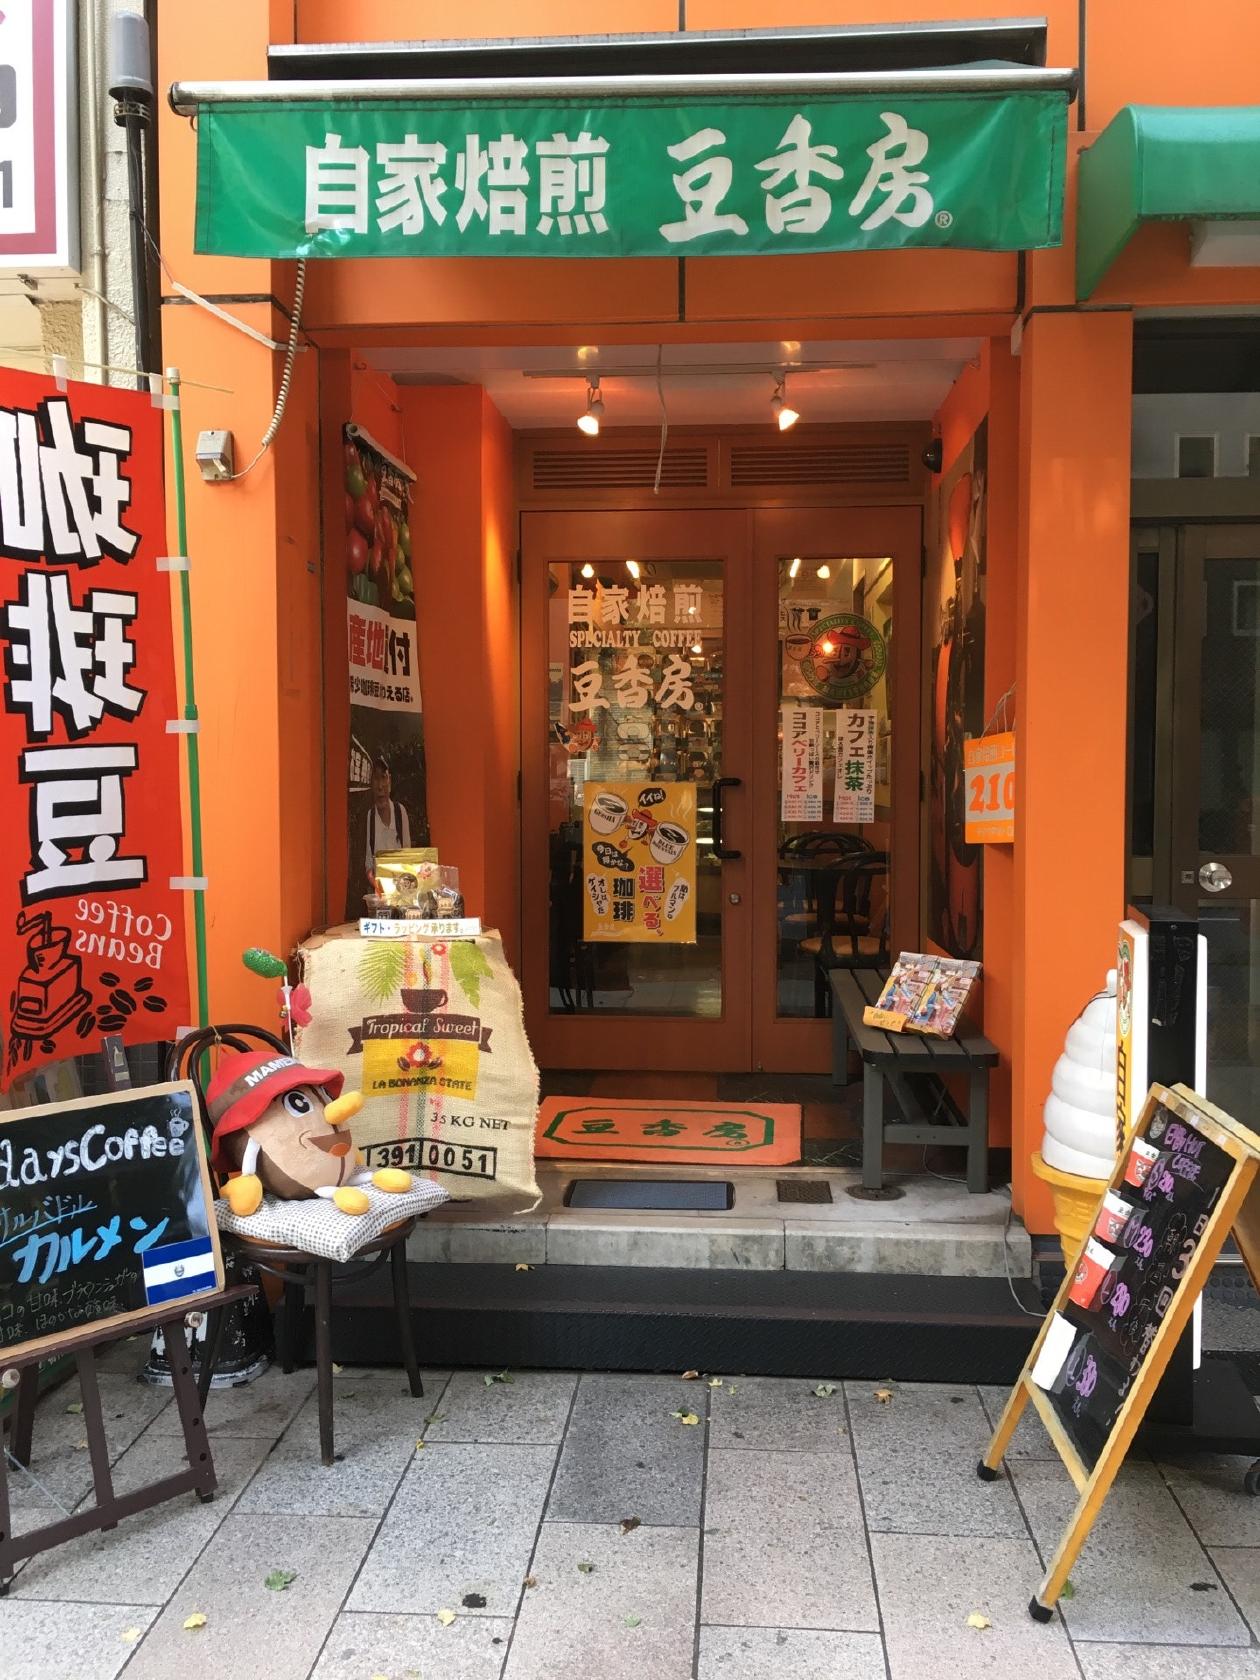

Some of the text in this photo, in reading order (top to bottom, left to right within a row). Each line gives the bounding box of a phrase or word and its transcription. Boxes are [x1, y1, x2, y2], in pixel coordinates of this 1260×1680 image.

[303, 111, 935, 243] 自家焙煎 豆香房
[568, 584, 704, 625] 自家焙煎
[652, 630, 703, 648] COFFEE
[568, 655, 695, 712] 豆香房
[845, 712, 865, 792] カフェ抹茶
[613, 877, 635, 922] 珈琲
[366, 1017, 479, 1039] Tropical Sweet
[372, 1076, 473, 1091] LA BONANZA STATE
[451, 1115, 475, 1128] KG
[480, 1116, 511, 1131] NET
[377, 1143, 488, 1172] 391 0051
[12, 1214, 171, 1284] カルメン
